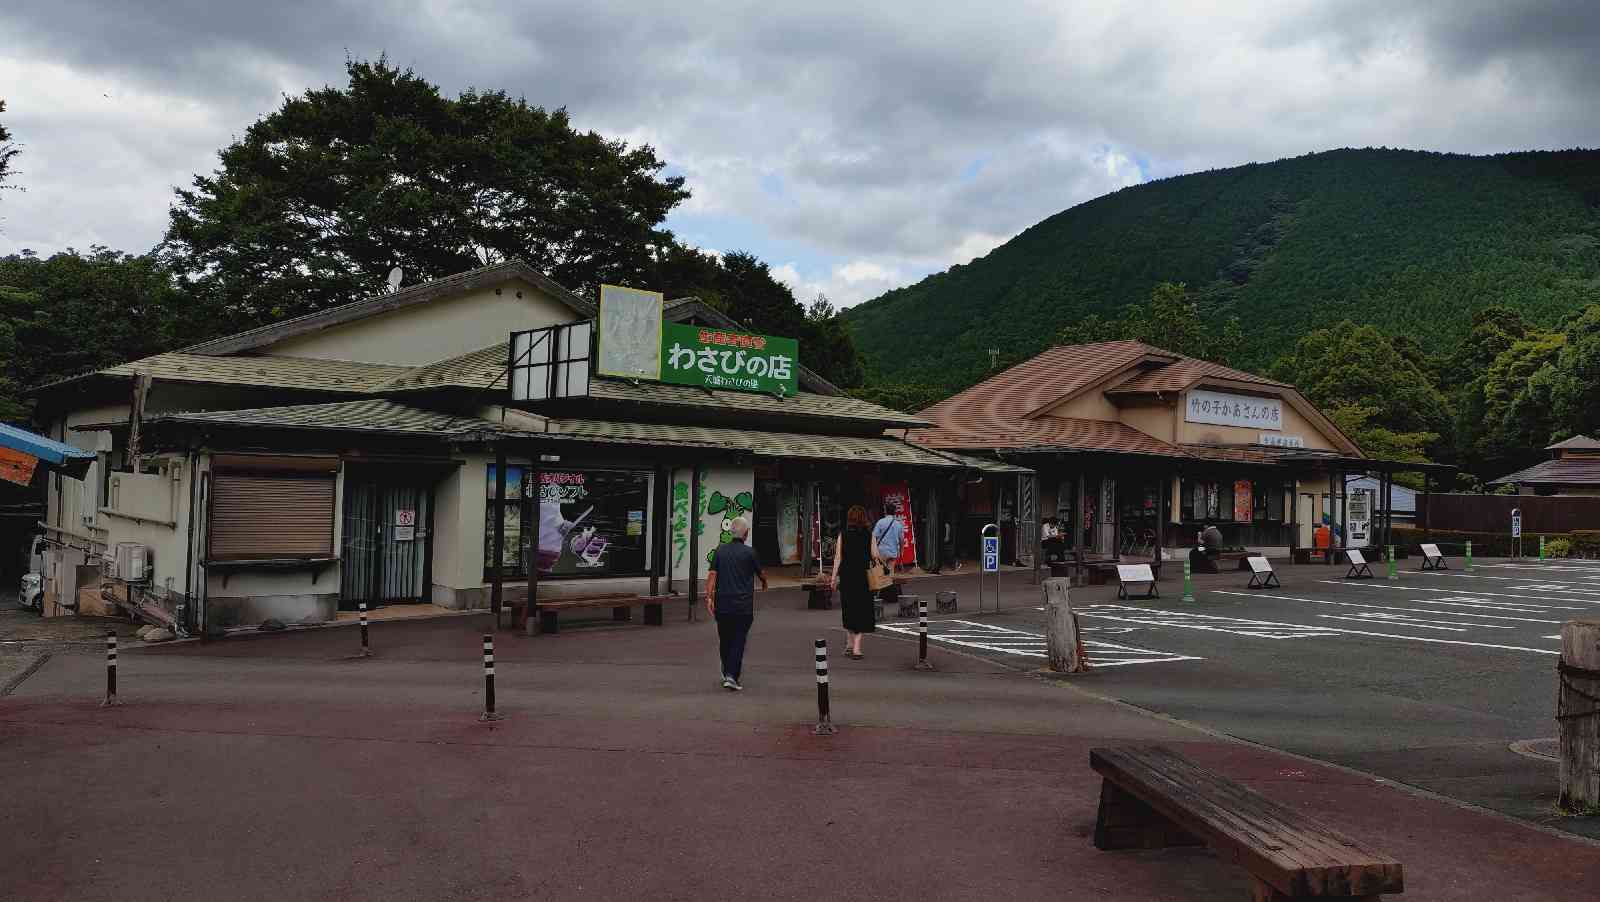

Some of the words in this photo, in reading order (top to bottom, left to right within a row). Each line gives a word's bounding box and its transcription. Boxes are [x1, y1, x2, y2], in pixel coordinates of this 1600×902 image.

[668, 342, 793, 379] わさびの店
[986, 556, 995, 569] P
